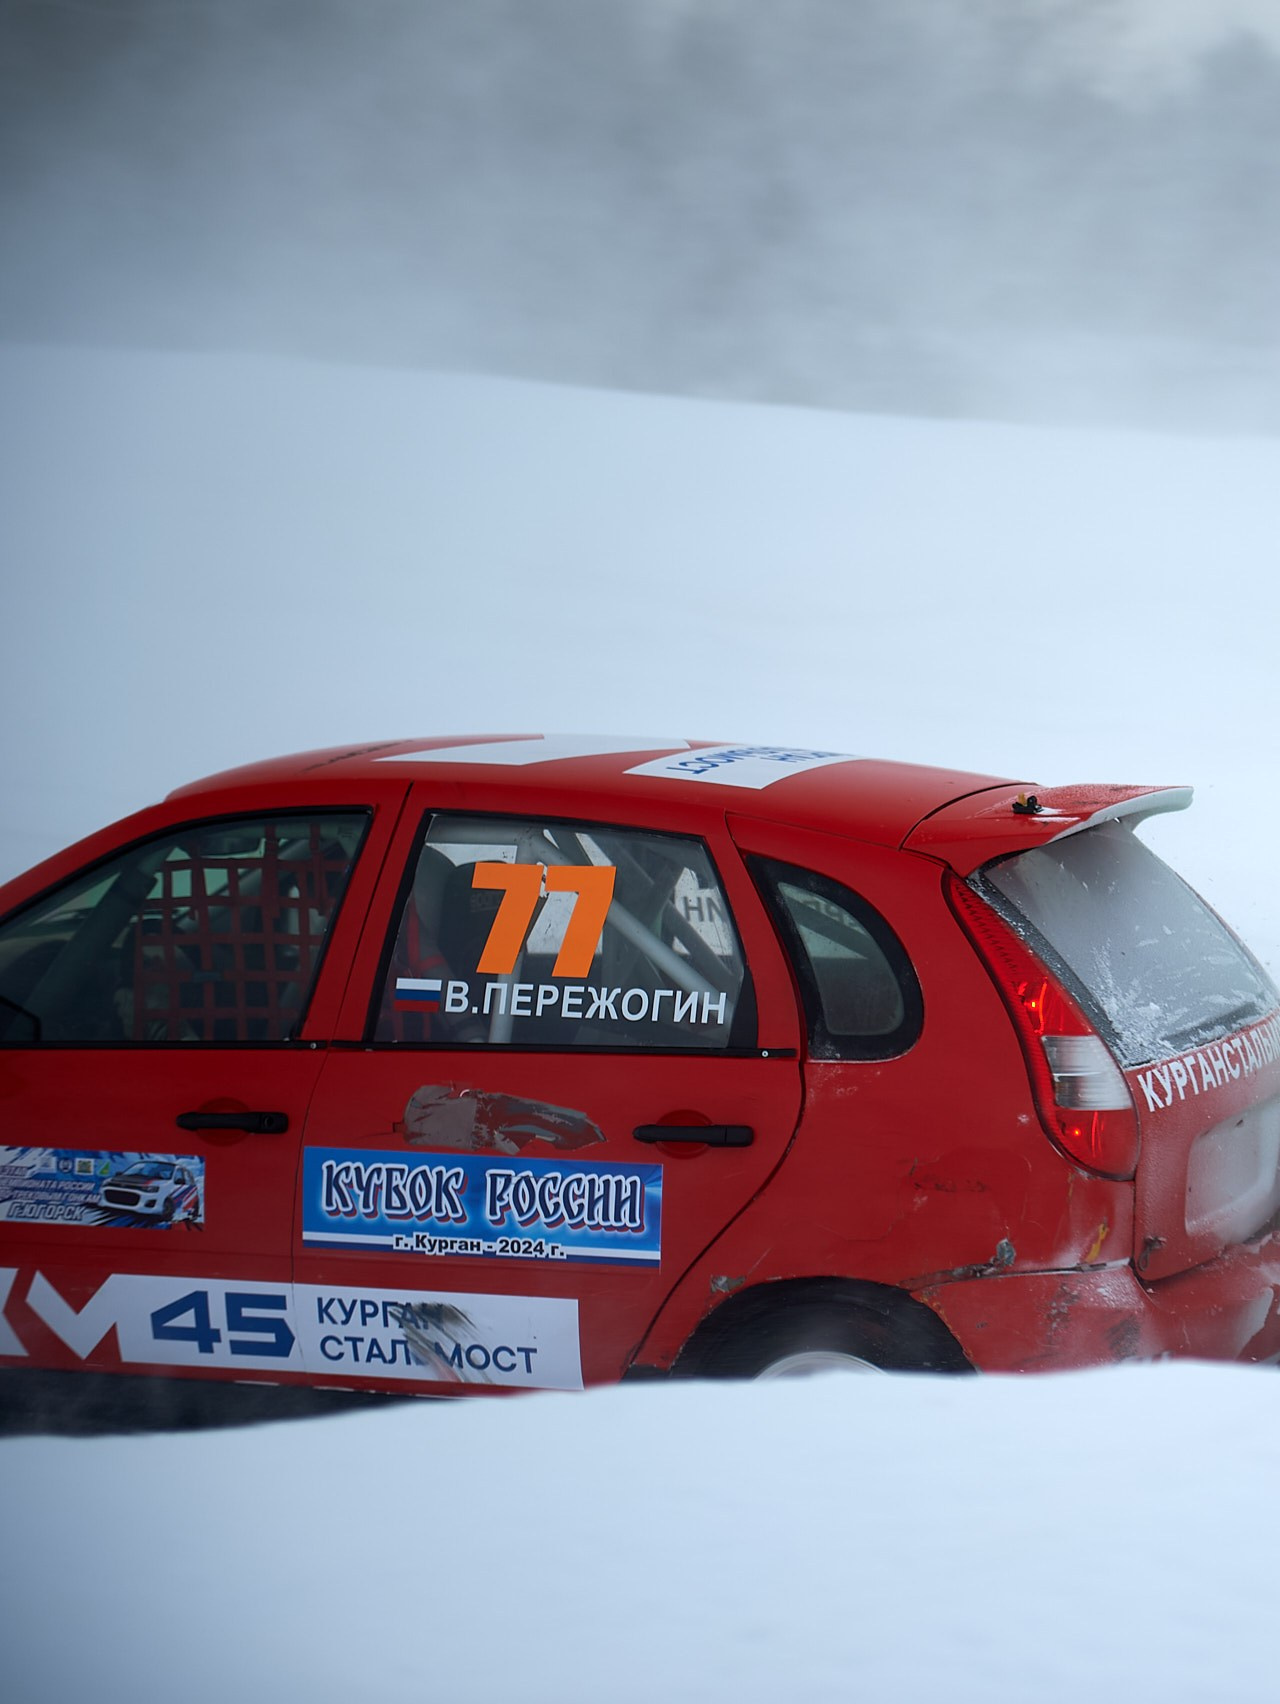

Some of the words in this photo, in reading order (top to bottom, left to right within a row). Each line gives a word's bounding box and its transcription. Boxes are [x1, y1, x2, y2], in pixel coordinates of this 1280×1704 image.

[471, 862, 617, 978] 77
[444, 980, 727, 1025] В.ПЕРЕЖОГИН
[322, 1160, 467, 1221] КУБОК
[485, 1169, 645, 1232] РОССИИ
[415, 1235, 481, 1255] Курган
[499, 1239, 545, 1256] 2024
[150, 1290, 295, 1358] 45
